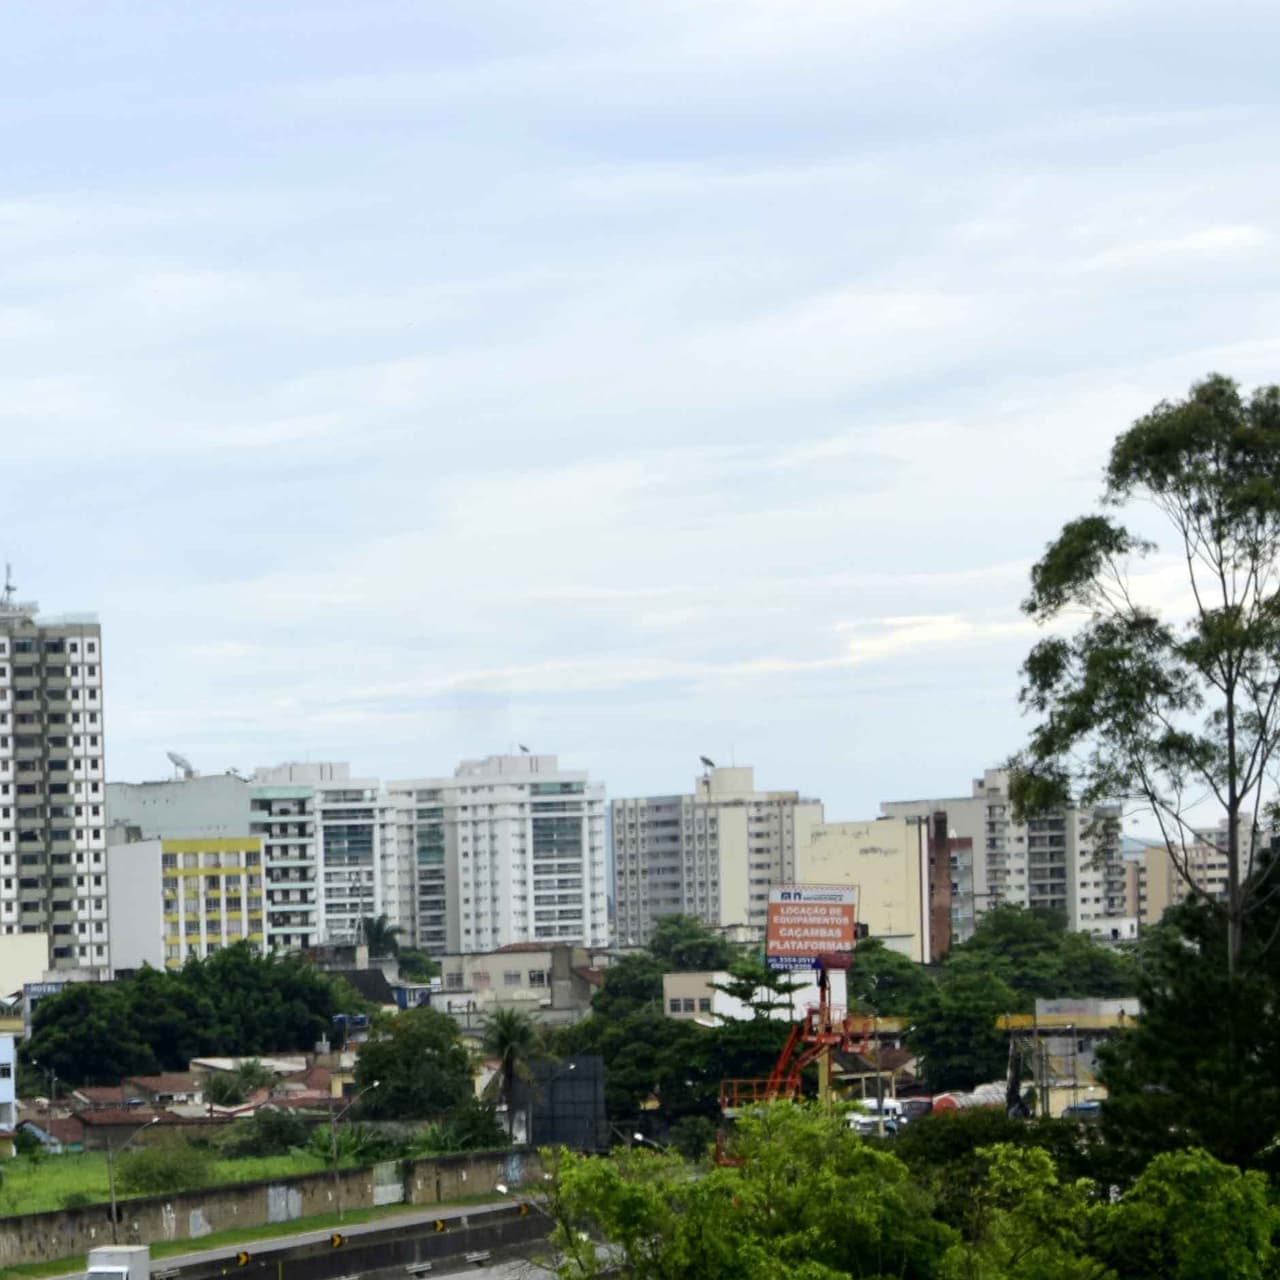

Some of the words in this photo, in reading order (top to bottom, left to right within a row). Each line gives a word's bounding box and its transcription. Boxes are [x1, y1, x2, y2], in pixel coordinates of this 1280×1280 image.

[780, 905, 827, 916] LOCAÇÃO
[829, 906, 843, 915] DE
[773, 916, 850, 925] EQUIPAMENTOS
[779, 927, 842, 938] CAÇAMBAS
[768, 941, 852, 951] PLATAFORMAS
